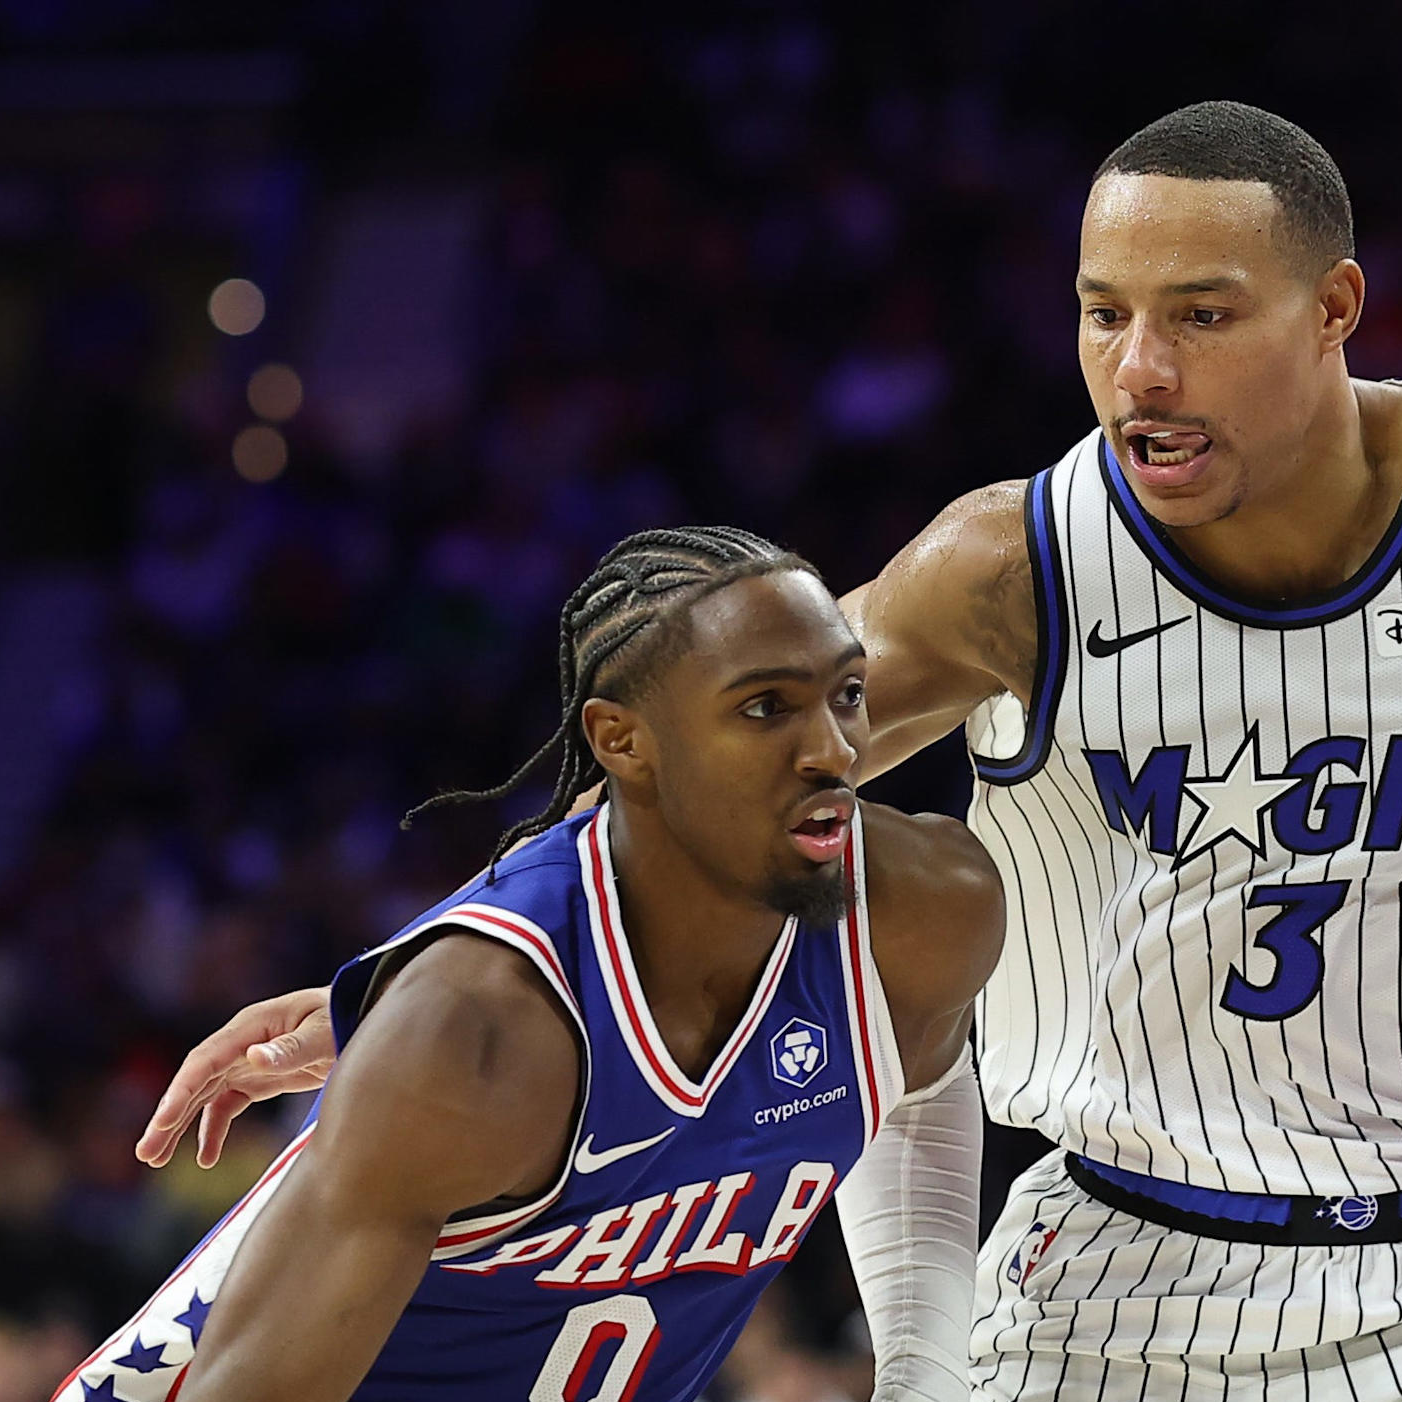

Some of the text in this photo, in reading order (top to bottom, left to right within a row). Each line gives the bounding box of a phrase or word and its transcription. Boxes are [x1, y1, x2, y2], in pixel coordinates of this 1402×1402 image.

[1219, 879, 1353, 1022] 3
[754, 1085, 847, 1125] crypto.com
[439, 1160, 838, 1290] PHILA
